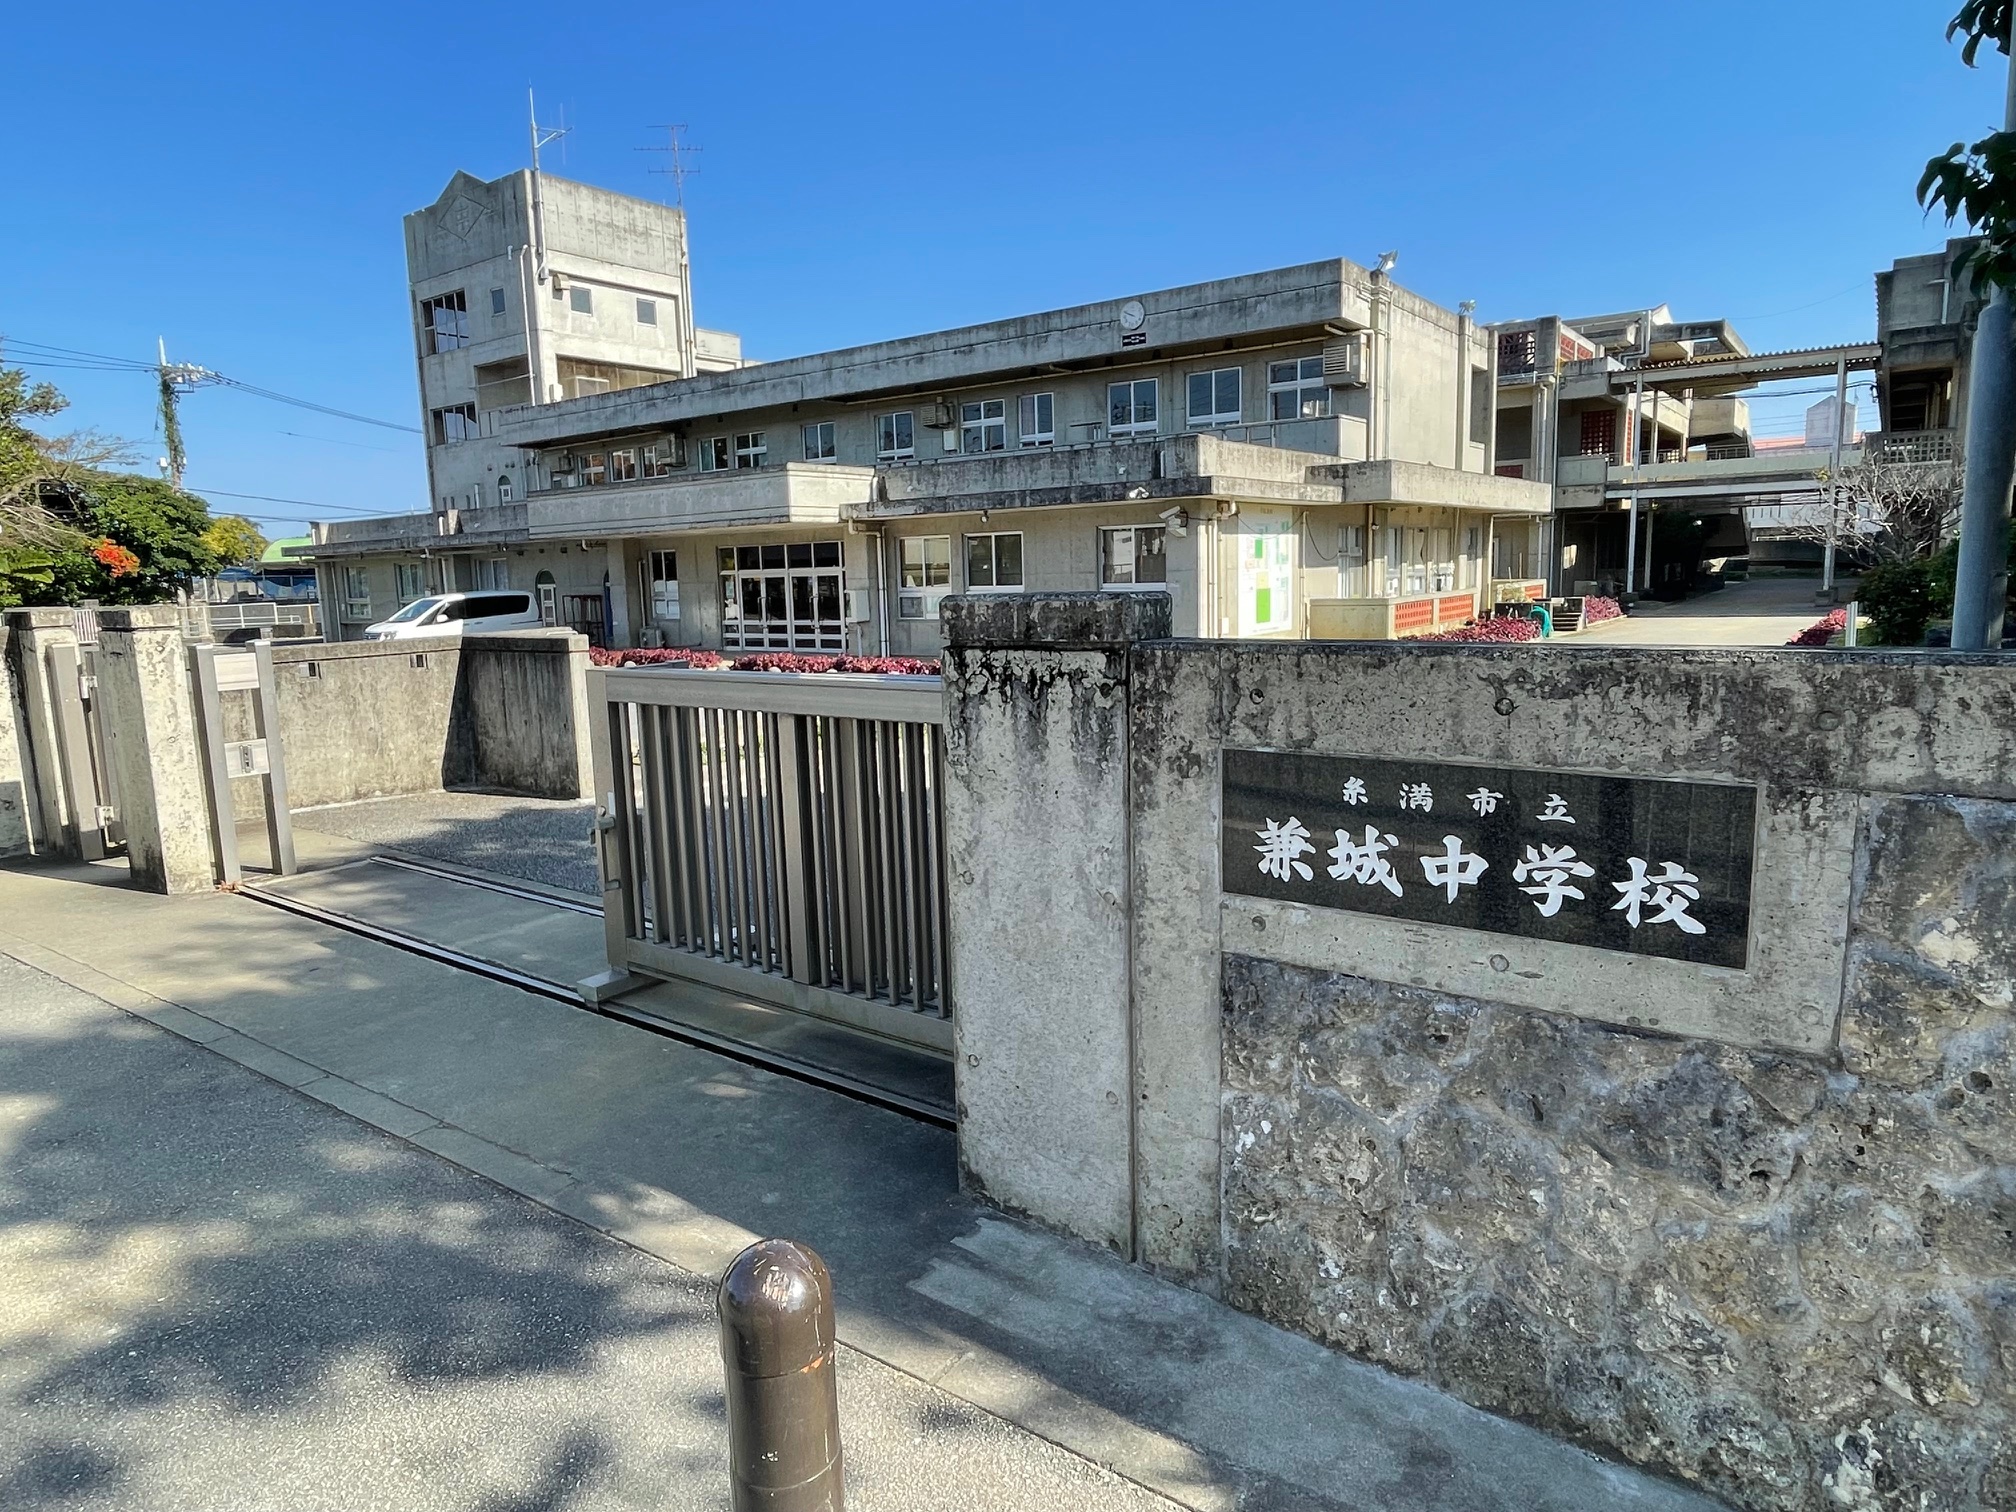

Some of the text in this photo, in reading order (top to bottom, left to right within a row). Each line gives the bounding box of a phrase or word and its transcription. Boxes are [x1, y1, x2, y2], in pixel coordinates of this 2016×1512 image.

[1341, 776, 1576, 825] 糸満市立
[1252, 816, 1707, 935] 兼城中学校
